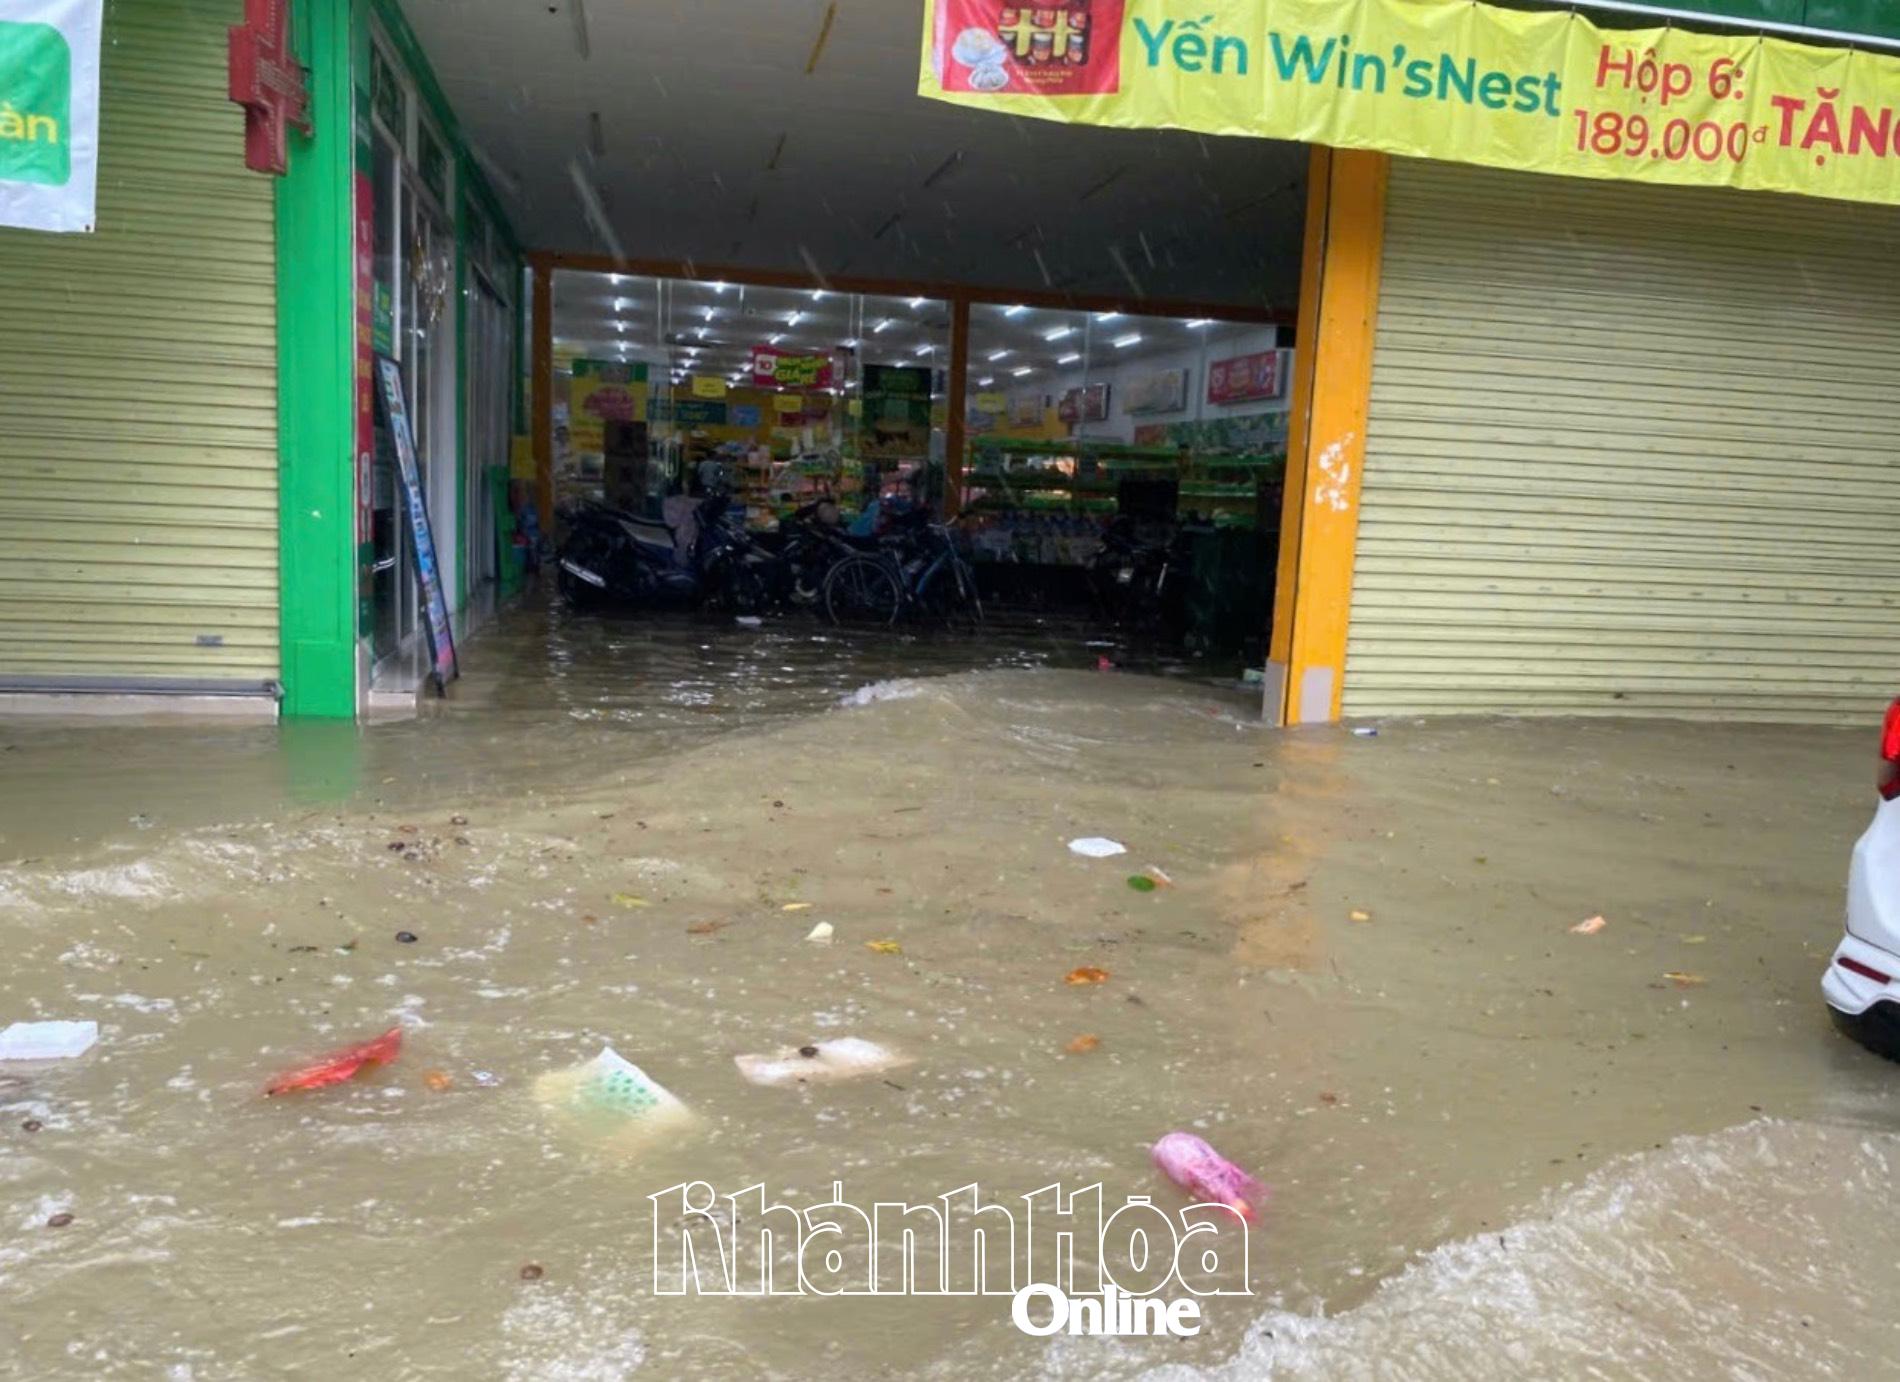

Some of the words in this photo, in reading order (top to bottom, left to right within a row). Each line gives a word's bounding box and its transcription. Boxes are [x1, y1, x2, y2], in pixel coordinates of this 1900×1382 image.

[1132, 15, 1248, 75] Yến
[1596, 45, 1692, 106] Hộp
[1708, 57, 1744, 100] 6:
[1771, 86, 1900, 167] TẶN
